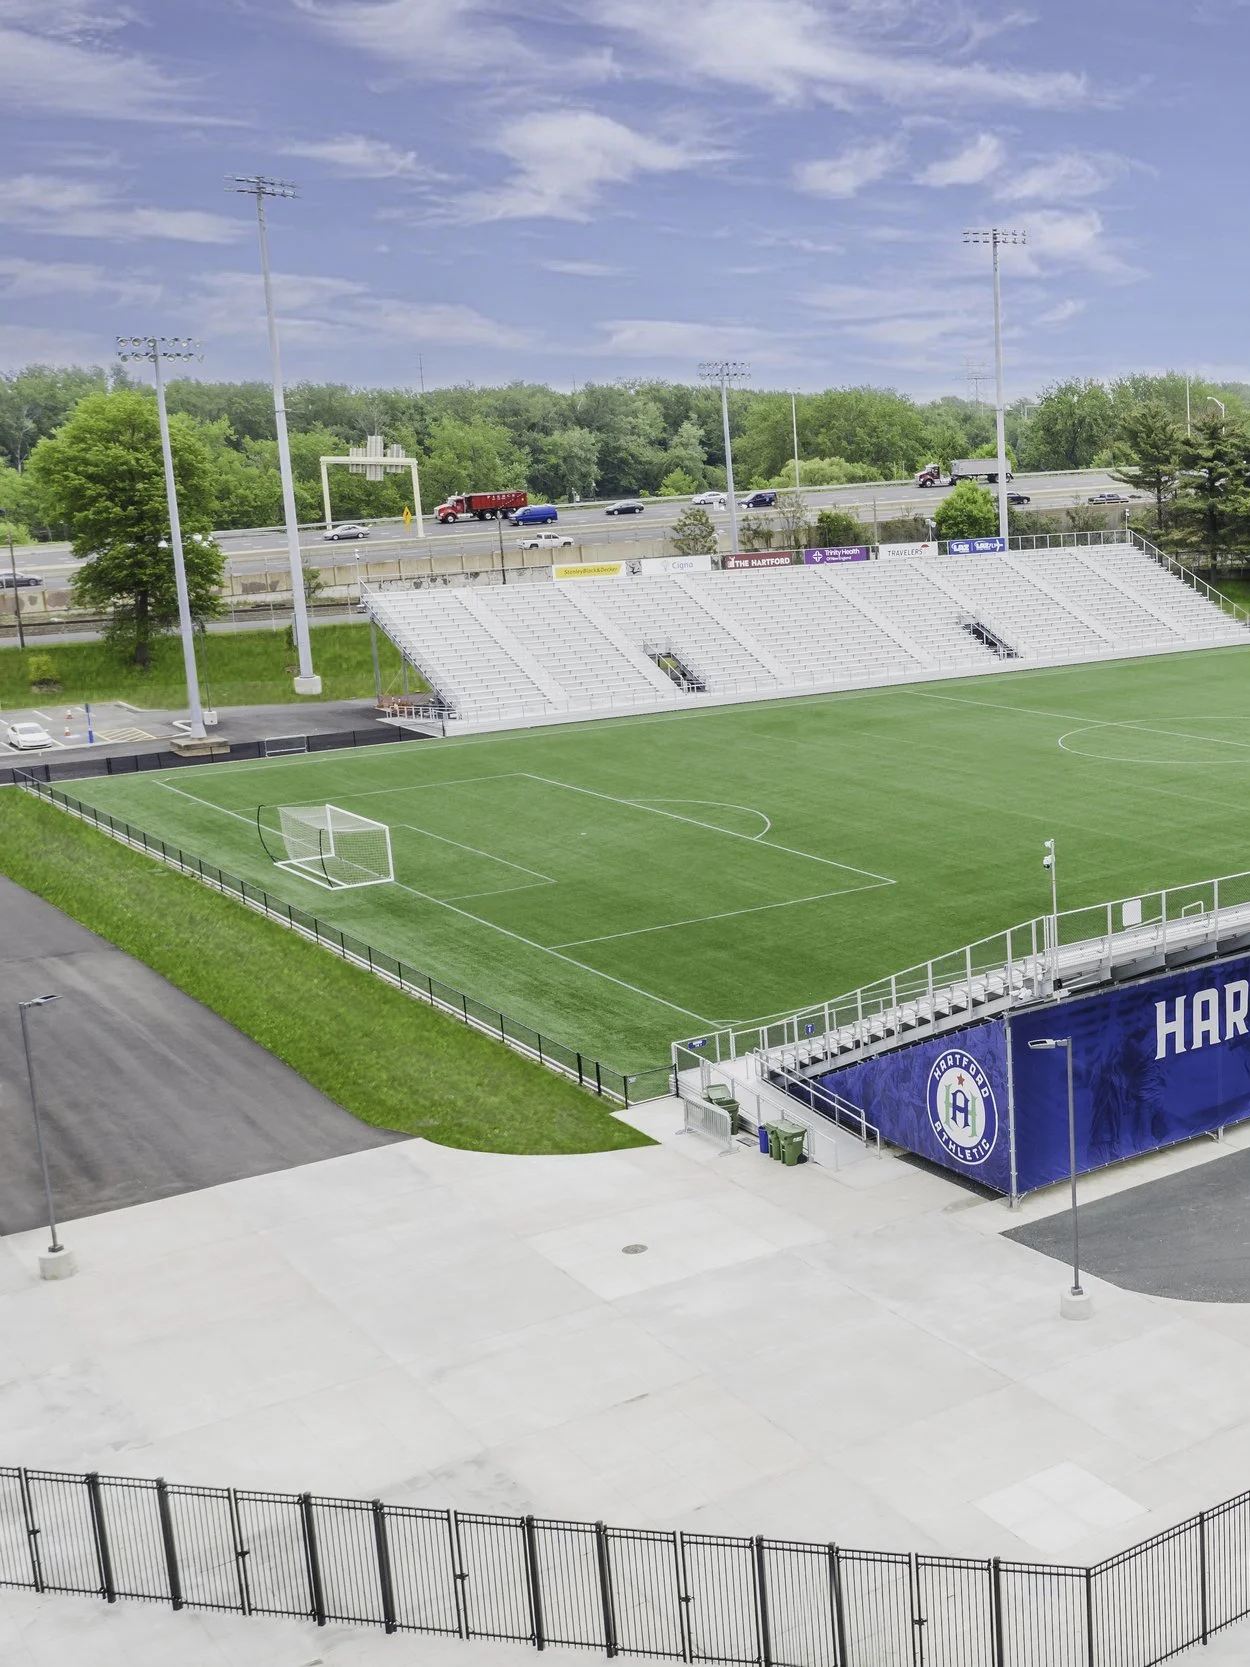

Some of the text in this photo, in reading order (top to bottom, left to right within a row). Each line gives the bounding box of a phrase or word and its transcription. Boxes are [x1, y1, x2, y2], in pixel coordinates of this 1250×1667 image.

[824, 549, 842, 557] Trinity
[672, 561, 694, 571] Cigna
[735, 557, 790, 568] THE HARTFORD
[933, 1054, 990, 1098] HARTFORD
[934, 1120, 990, 1160] ATHLETIC
